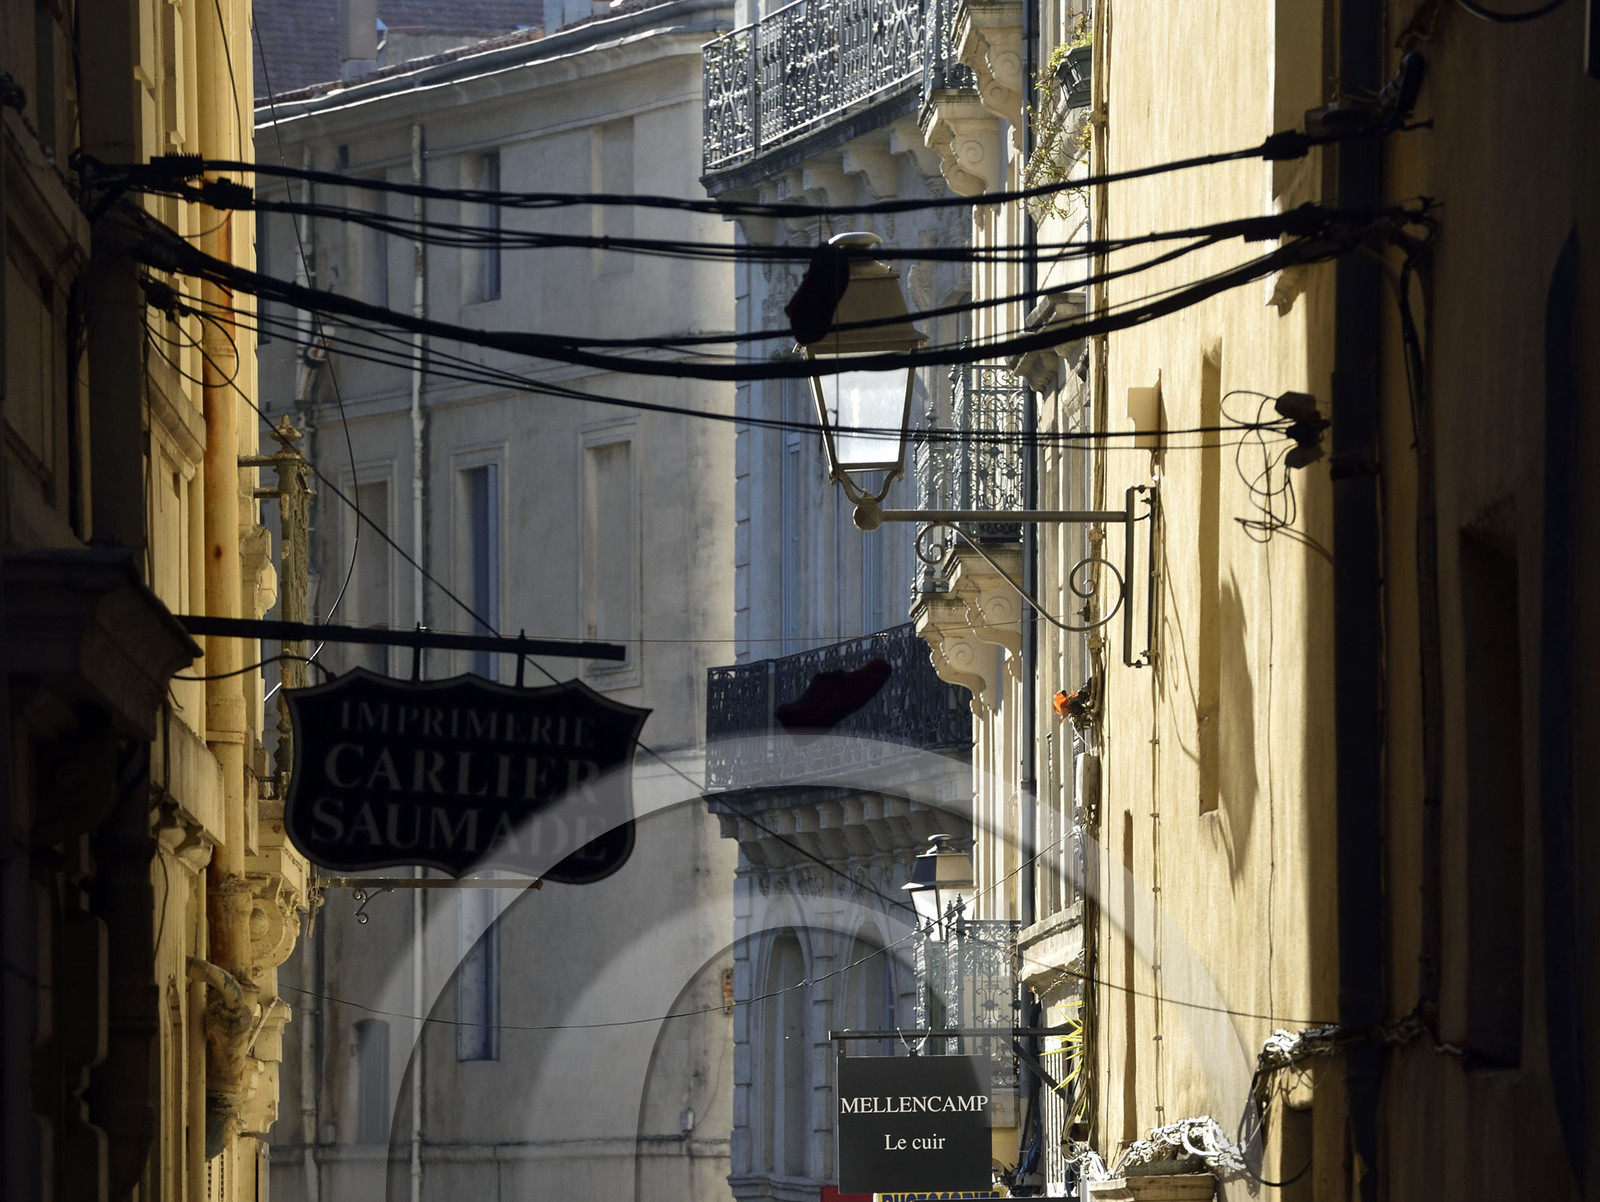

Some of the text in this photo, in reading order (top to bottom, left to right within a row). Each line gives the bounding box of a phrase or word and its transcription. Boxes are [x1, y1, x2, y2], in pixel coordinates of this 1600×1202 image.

[340, 699, 595, 748] IMPRIMERIE
[323, 742, 601, 804] CARLIER
[310, 796, 608, 861] SAUMADE
[840, 1095, 988, 1114] MELLENCAMP
[884, 1133, 946, 1151] Le cuir
